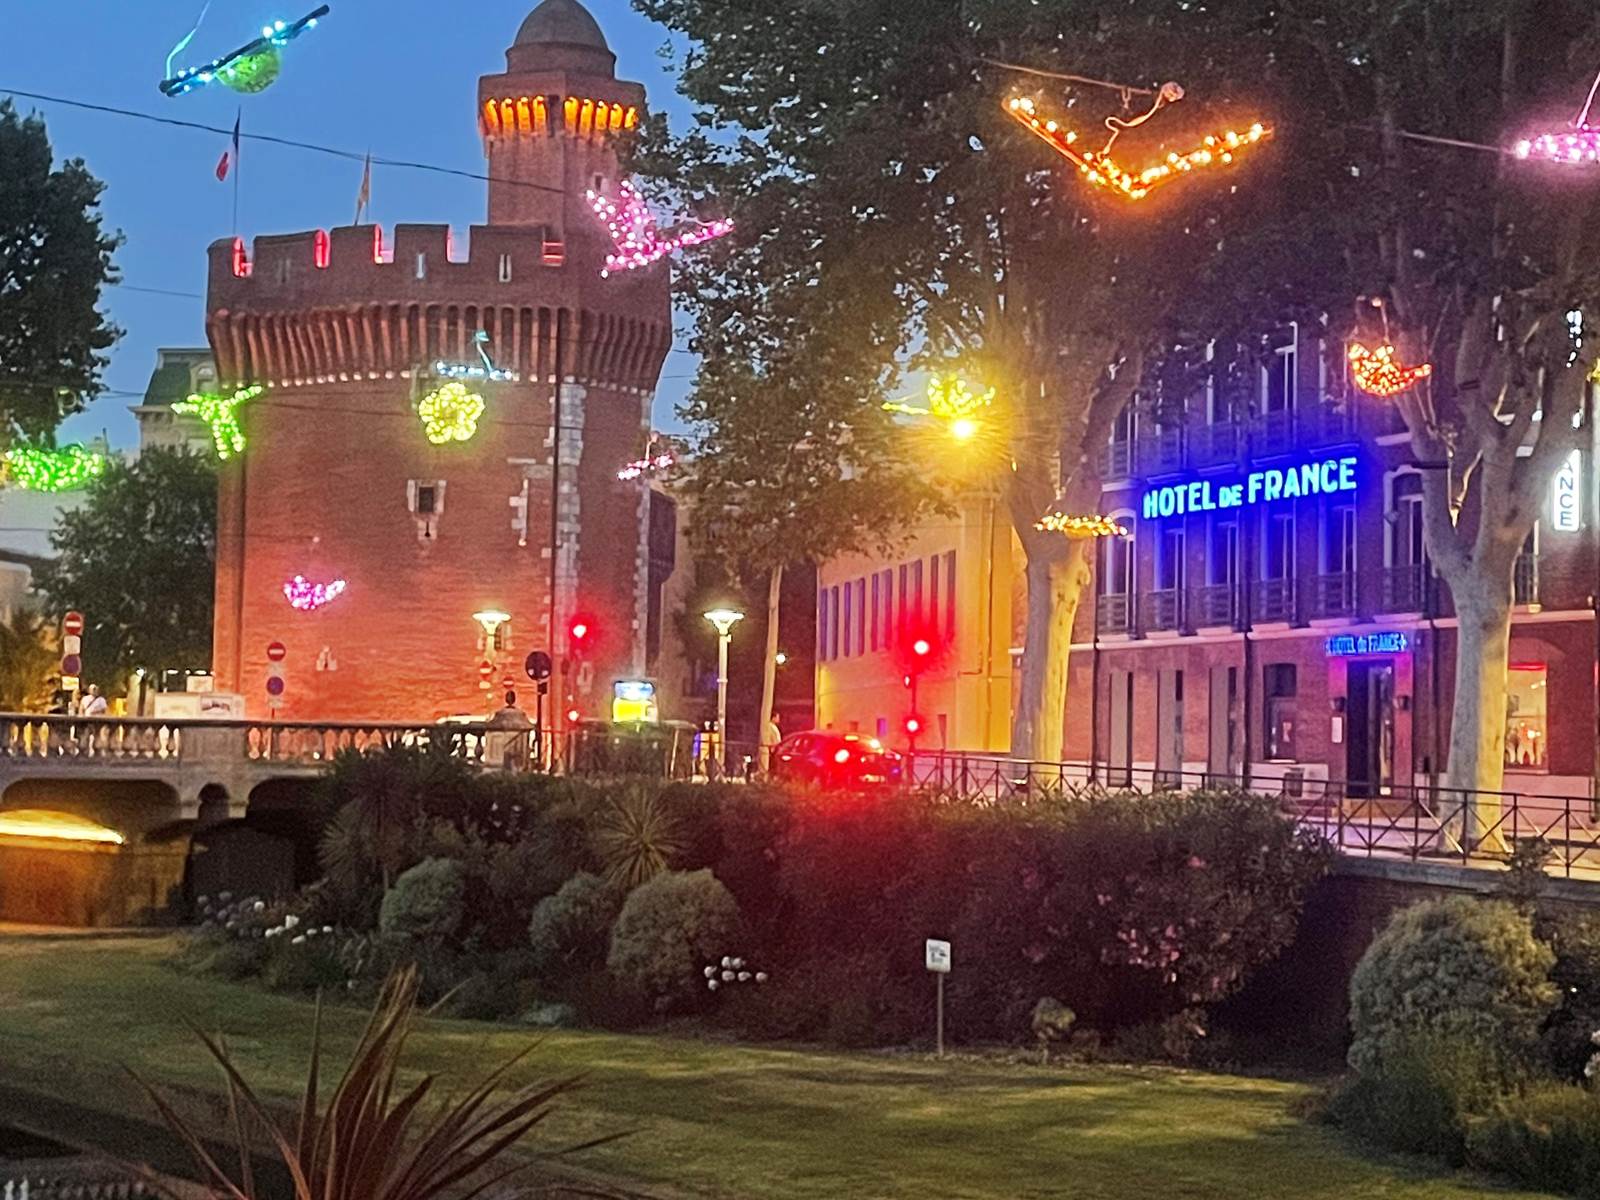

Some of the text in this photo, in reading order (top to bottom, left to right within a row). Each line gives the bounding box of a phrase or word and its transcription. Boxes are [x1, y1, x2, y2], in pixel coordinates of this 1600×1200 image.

[1143, 457, 1357, 519] HOTEL DE FRANCE
